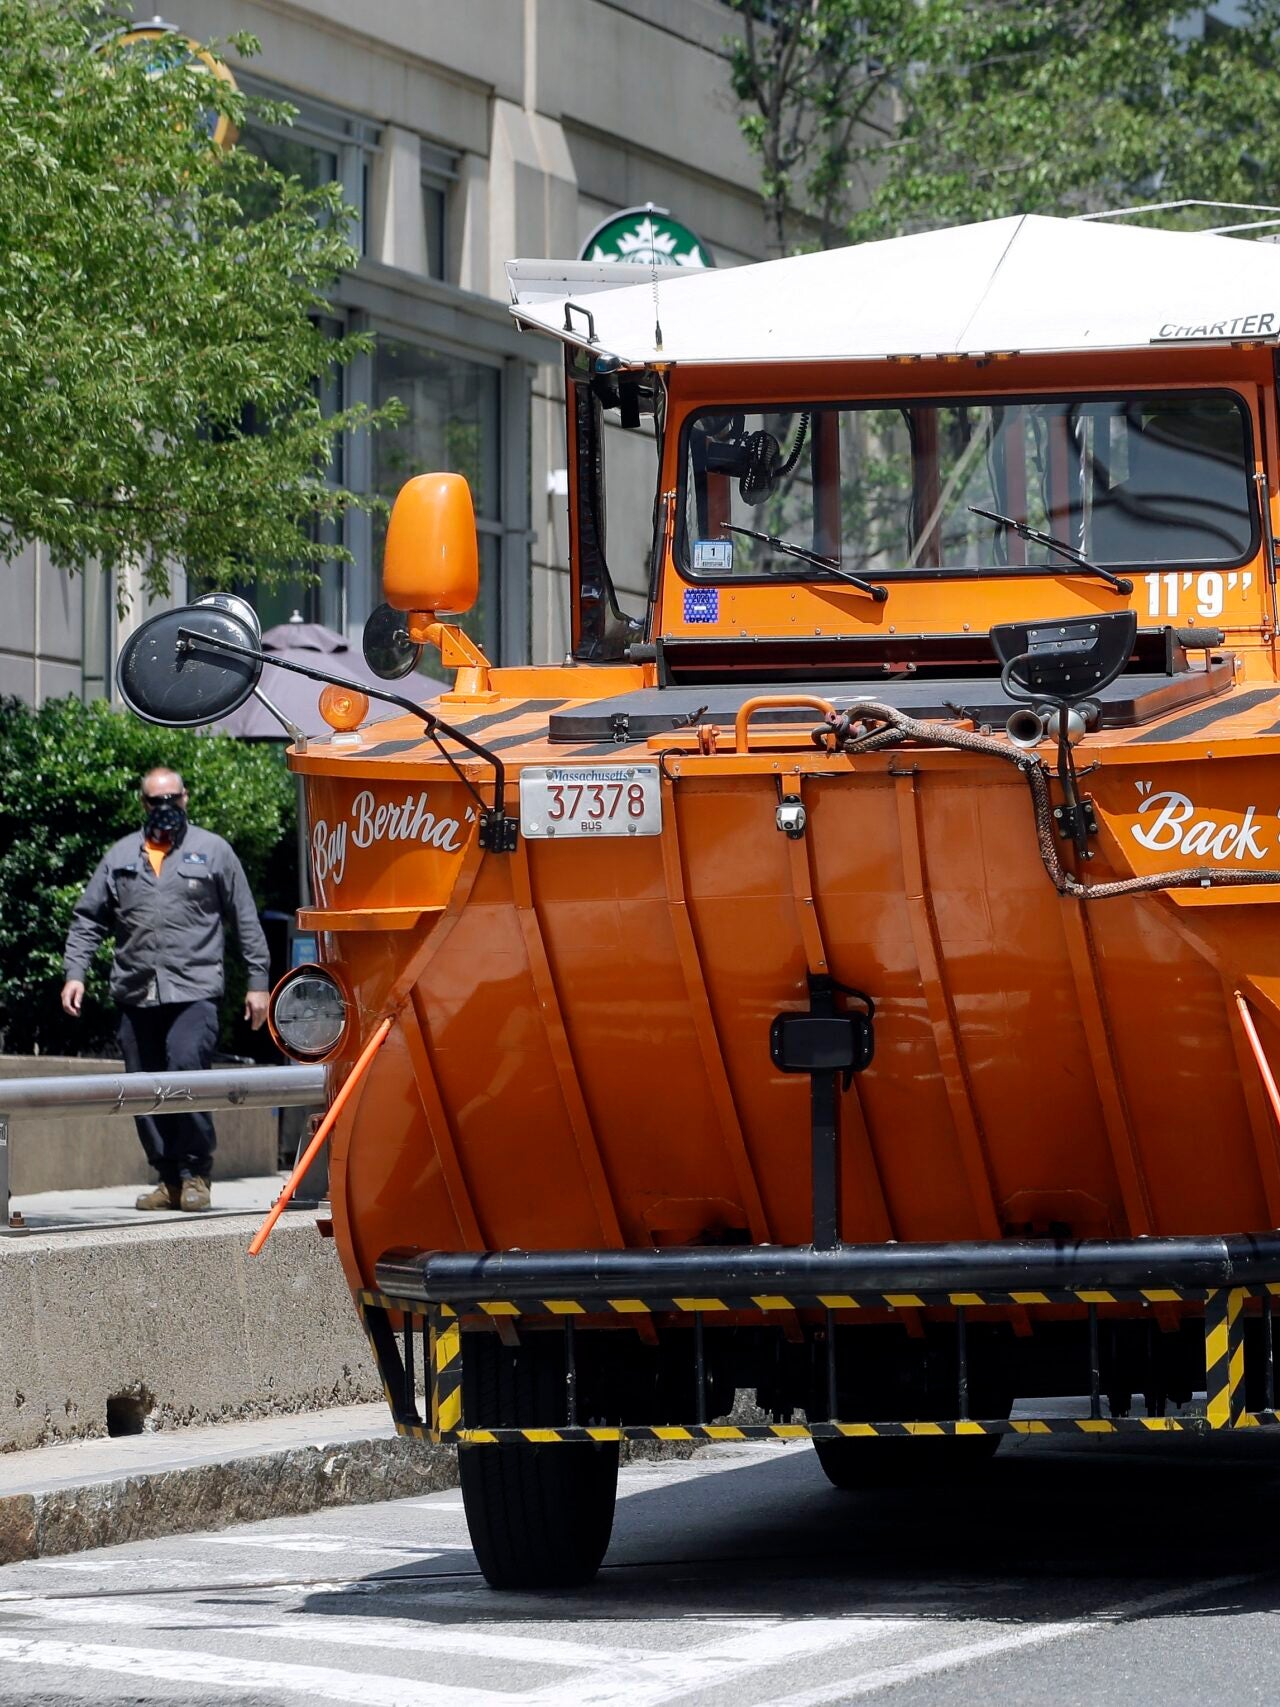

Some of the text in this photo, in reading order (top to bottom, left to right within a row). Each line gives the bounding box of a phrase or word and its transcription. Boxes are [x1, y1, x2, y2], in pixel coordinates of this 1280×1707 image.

[1158, 312, 1275, 338] CHARTER
[552, 769, 630, 782] Massachusetts
[547, 783, 645, 820] 37378
[580, 821, 603, 832] BUS
[313, 820, 348, 884] Bay
